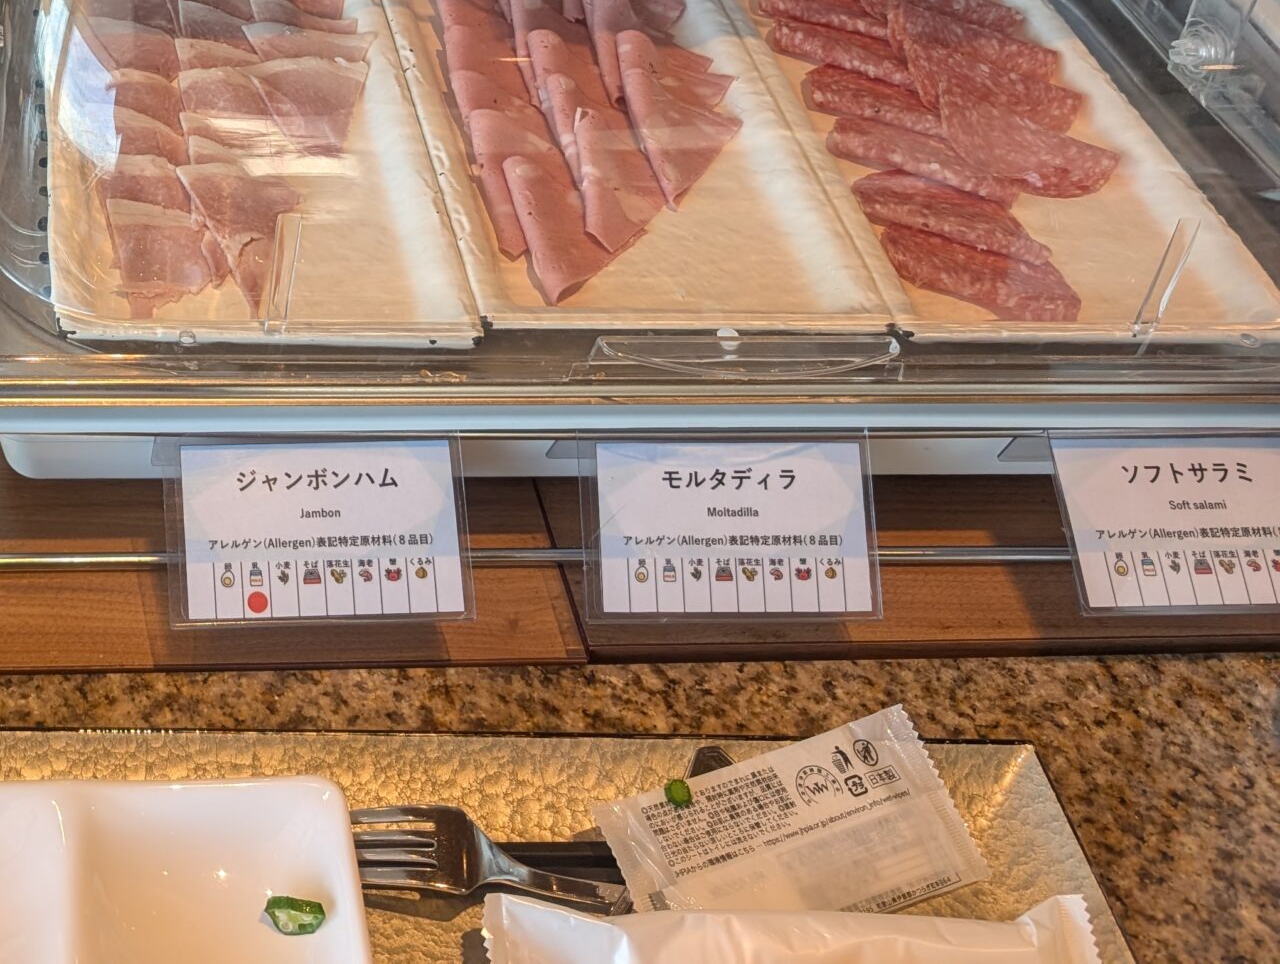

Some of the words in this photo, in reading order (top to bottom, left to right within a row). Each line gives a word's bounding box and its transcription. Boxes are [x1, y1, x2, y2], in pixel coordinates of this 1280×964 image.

[1121, 462, 1253, 484] ソフトサラミ
[236, 467, 398, 492] ジャンボンハム
[662, 468, 796, 490] モルタディラ
[1169, 500, 1191, 510] Soft
[1193, 500, 1227, 510] salami
[300, 508, 340, 519] Jambon
[707, 507, 759, 518] Moltadilla
[410, 557, 432, 566] くるみ
[819, 558, 842, 566] くるみ
[869, 769, 897, 785] 日本製
